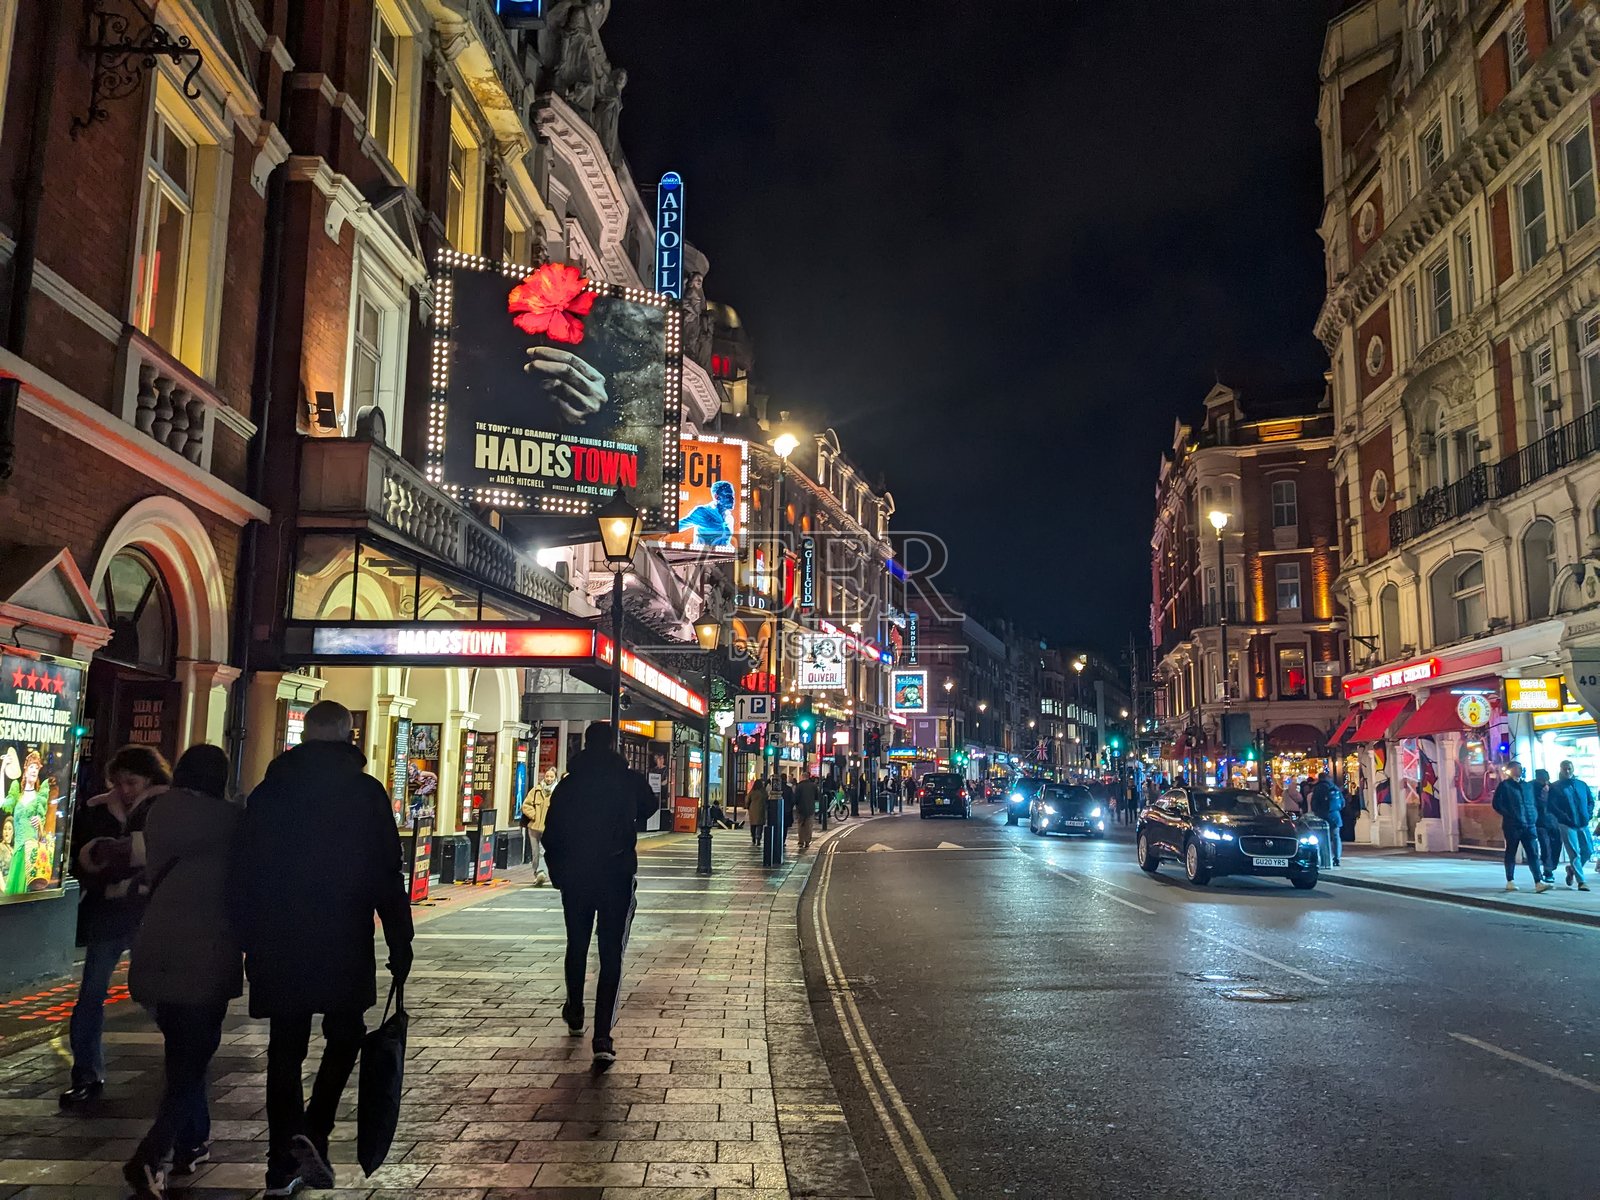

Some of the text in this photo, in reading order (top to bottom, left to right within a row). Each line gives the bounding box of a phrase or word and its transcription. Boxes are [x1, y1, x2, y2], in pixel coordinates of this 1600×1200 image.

[476, 422, 487, 431] THE
[512, 427, 523, 436] AND
[560, 434, 602, 447] AWARD-WINNING
[603, 438, 616, 449] BEST
[616, 440, 639, 452] MUSICAL
[684, 444, 699, 452] STORY
[474, 433, 638, 489] HADESTOWN
[516, 477, 546, 488] MITCHELL
[576, 484, 598, 495] RACHEL
[804, 550, 813, 603] GIELGUD
[397, 630, 507, 654] HADESTOWN
[808, 672, 838, 683] OLIVER!
[33, 691, 57, 708] MOST
[1520, 690, 1548, 700] MOBILE
[0, 702, 54, 723] EXHILARATING
[134, 714, 153, 728] OVER
[480, 764, 491, 772] THE
[1255, 858, 1286, 866] GU20 YRS
